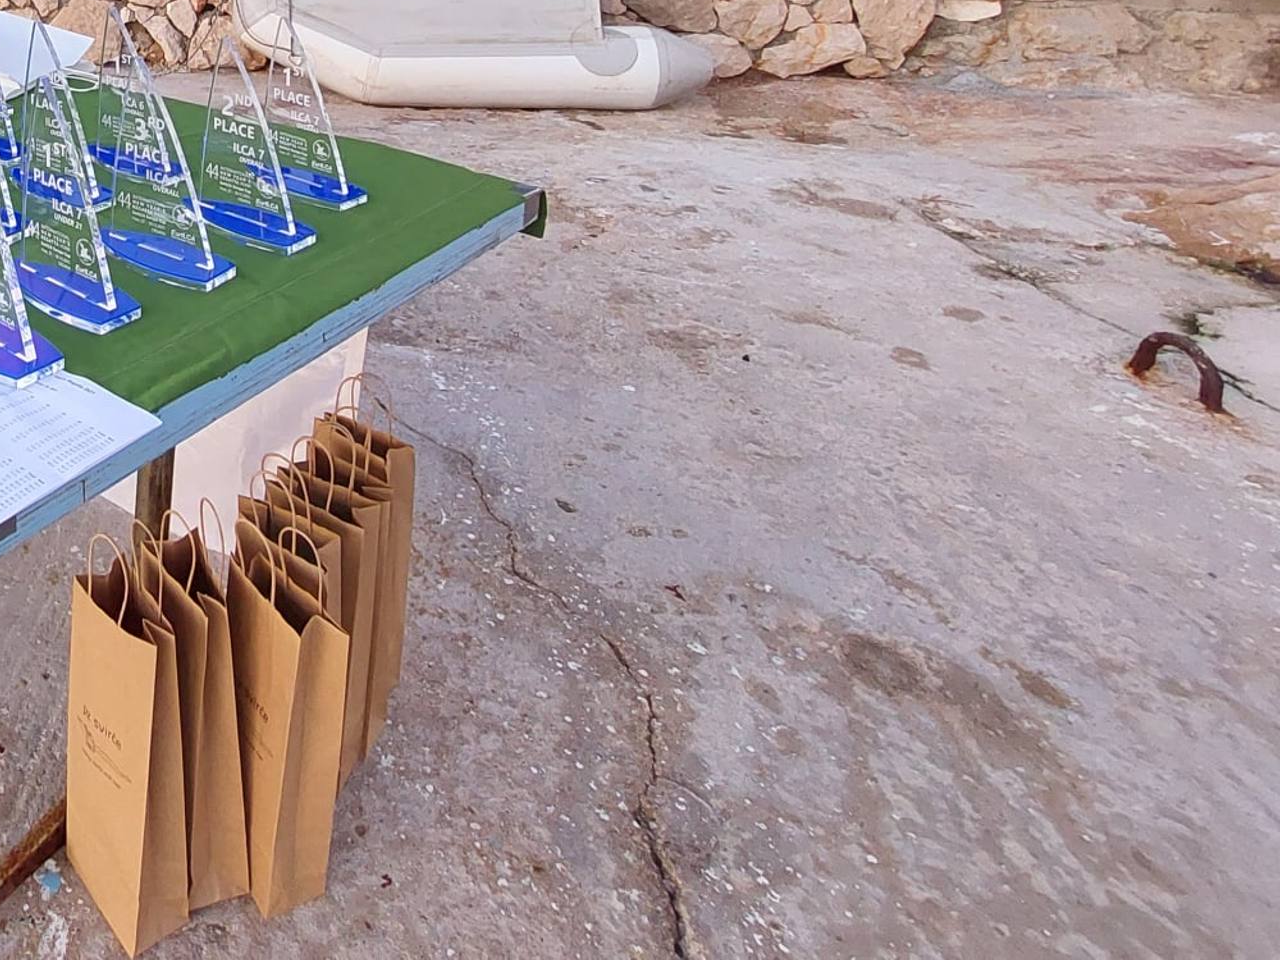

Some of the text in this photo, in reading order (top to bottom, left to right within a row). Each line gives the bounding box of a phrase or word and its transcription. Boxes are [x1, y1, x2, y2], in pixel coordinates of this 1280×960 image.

[283, 67, 304, 87] 1ST
[221, 93, 253, 117] 2ND
[273, 87, 312, 107] PLACE
[290, 109, 321, 126] ILCA 7
[213, 117, 255, 140] PLACE
[42, 142, 66, 168] 1ST
[233, 142, 265, 160] ILCA 7
[33, 167, 73, 196] PLACE
[146, 168, 169, 187] ILCA
[206, 162, 219, 181] 44
[52, 197, 82, 220] ILCA 7
[117, 191, 132, 210] 44
[53, 212, 75, 228] UNDER
